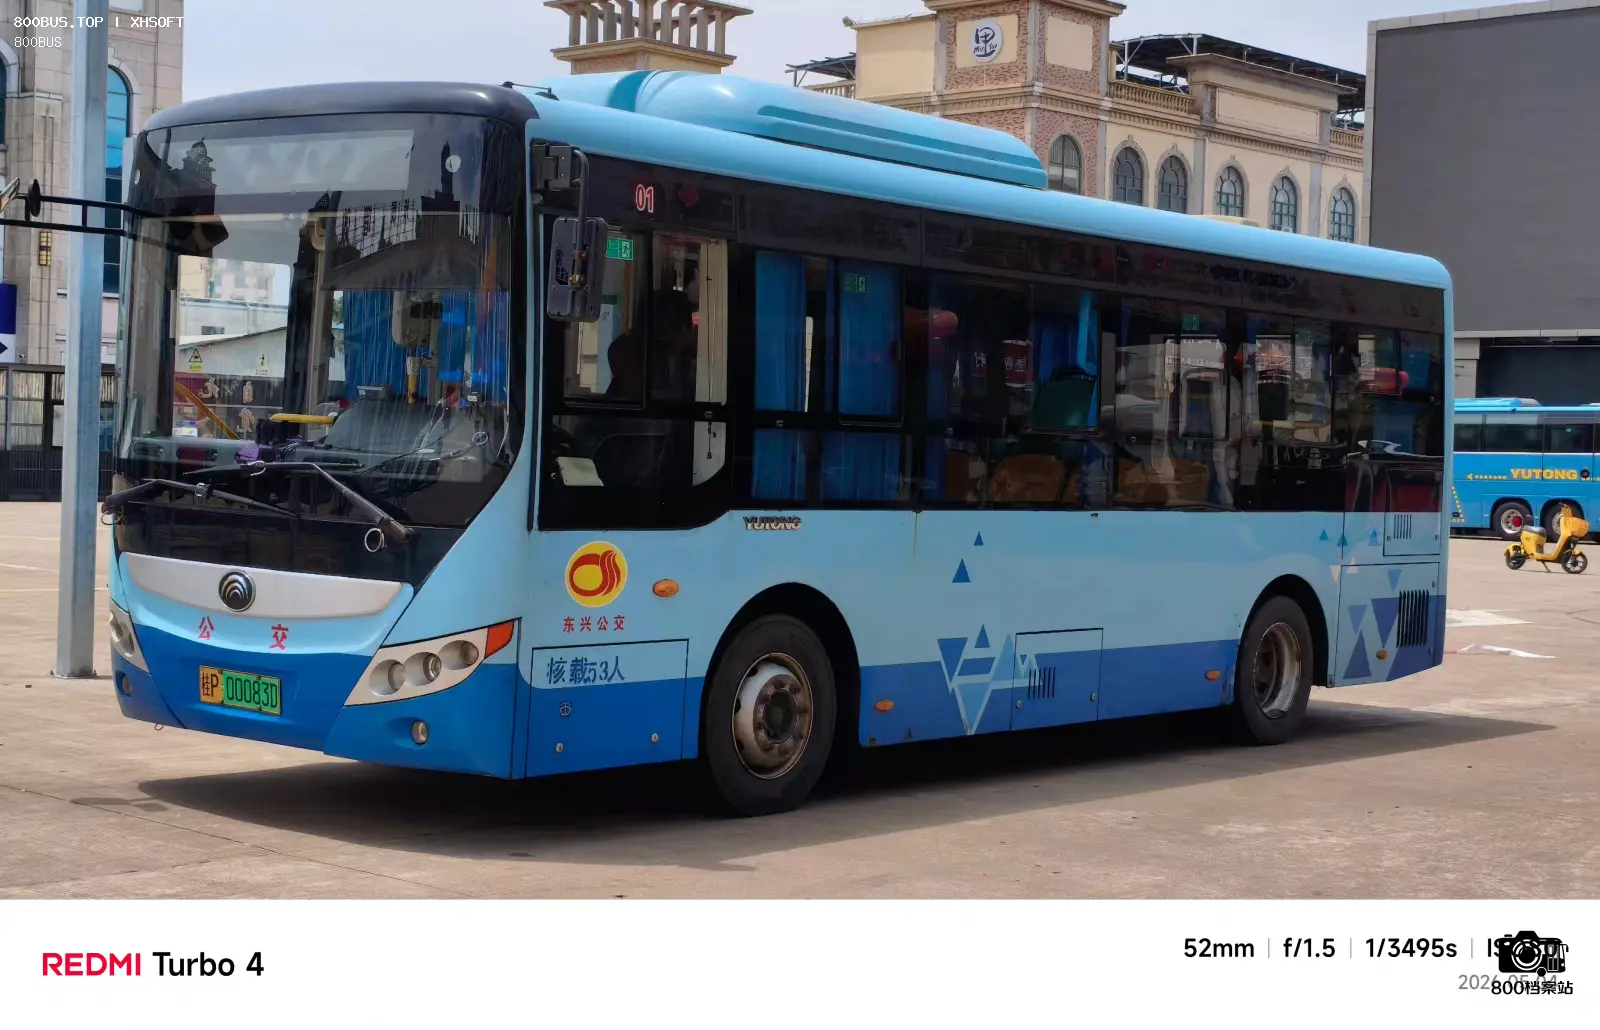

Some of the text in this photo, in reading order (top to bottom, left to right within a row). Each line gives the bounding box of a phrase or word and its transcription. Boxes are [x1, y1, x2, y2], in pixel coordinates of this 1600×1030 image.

[636, 184, 654, 213] 01
[1510, 468, 1578, 480] YUTONG
[742, 516, 802, 531] YUTONG
[197, 615, 289, 651] 公交
[563, 615, 625, 633] 东兴公交
[546, 655, 625, 685] 核载53人
[201, 671, 278, 708] 桂P 00083D
